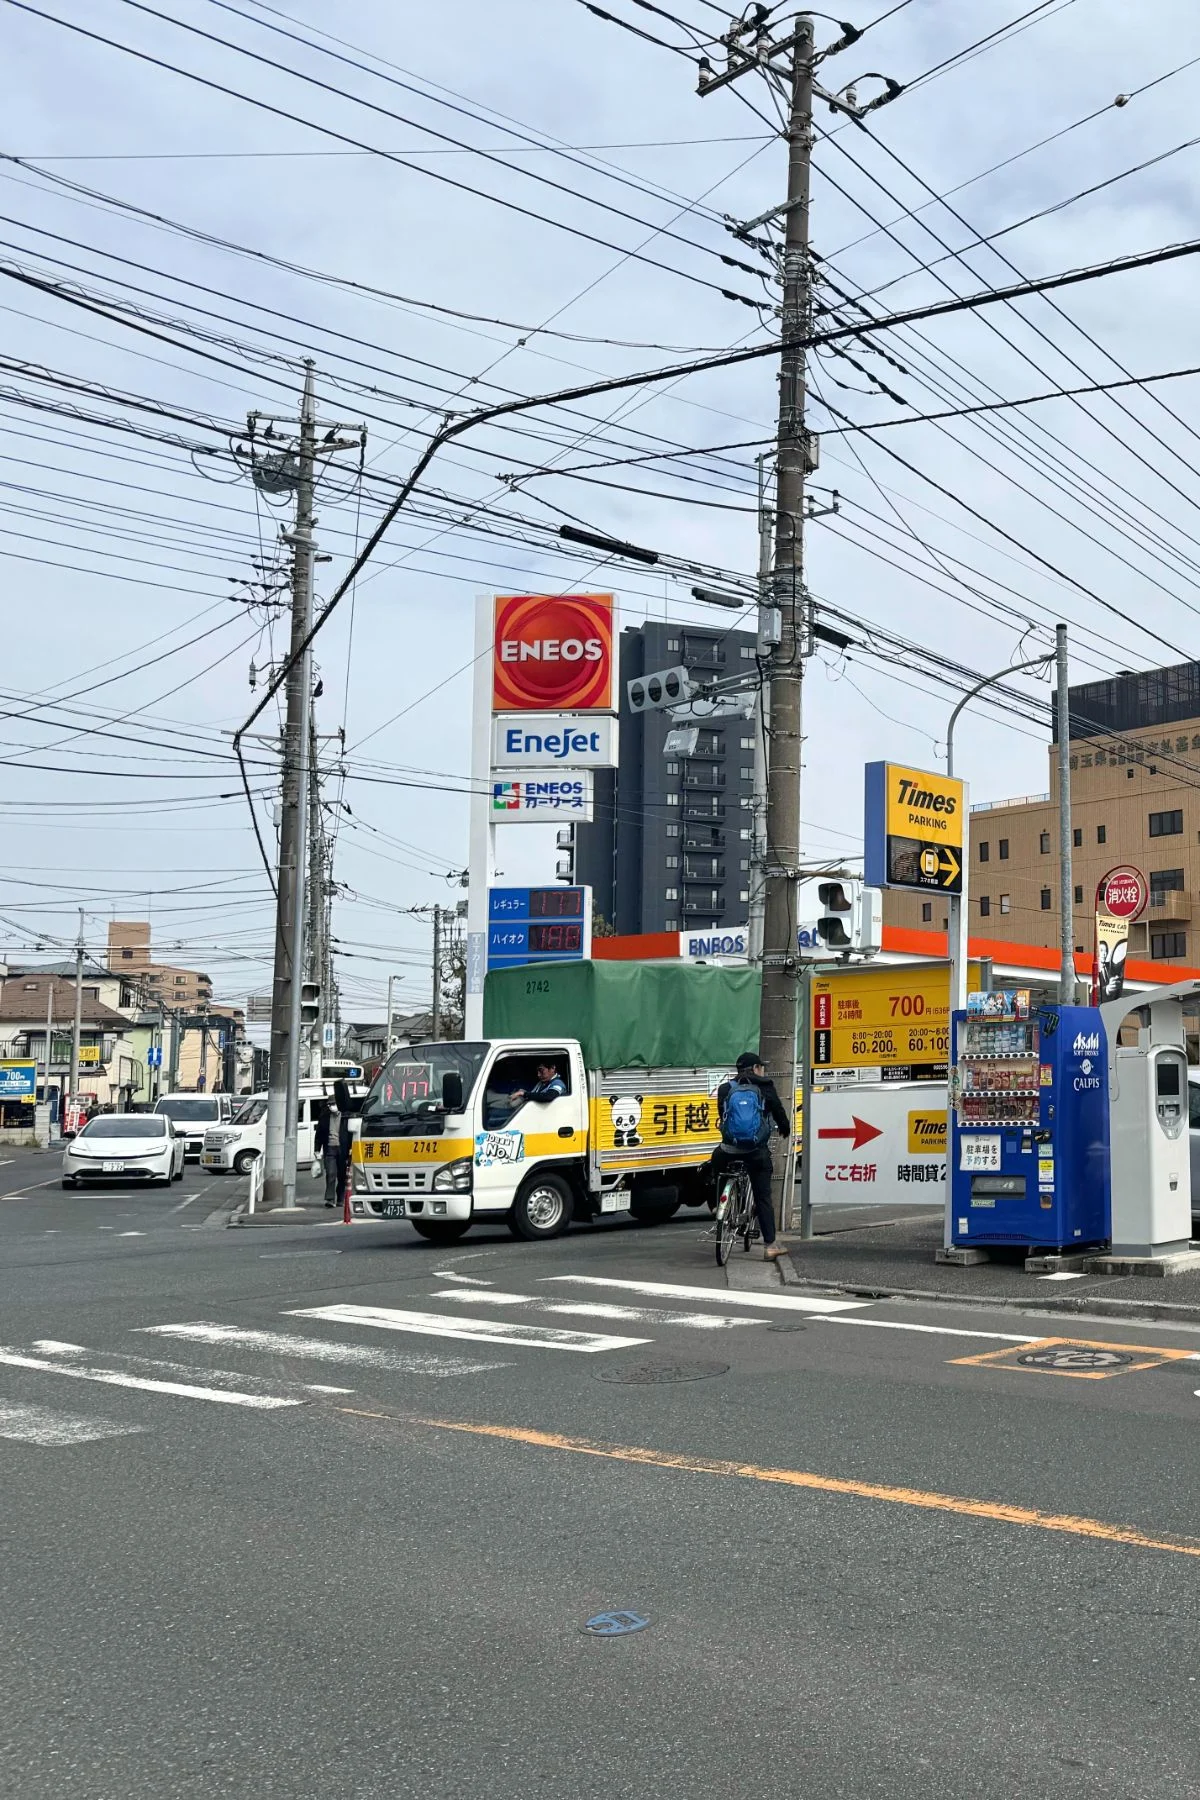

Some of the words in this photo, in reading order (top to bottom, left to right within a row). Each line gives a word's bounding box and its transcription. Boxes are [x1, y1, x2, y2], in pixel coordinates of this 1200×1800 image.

[501, 638, 603, 662] ENEOS
[525, 782, 583, 795] ENEOS
[525, 796, 583, 809] カーリース
[898, 779, 956, 815] Times
[908, 813, 947, 830] PARKING
[1108, 886, 1138, 904] 消火栓
[493, 899, 526, 910] レギュラー
[542, 891, 581, 914] 177
[493, 933, 525, 944] ハイオク
[689, 935, 745, 956] ENEOS
[526, 980, 550, 994] 2742
[838, 1000, 860, 1010] 駐車後
[838, 1010, 862, 1021] 24時間
[1073, 1032, 1100, 1050] Asahi
[1073, 1077, 1100, 1091] CALPIS
[913, 1119, 947, 1135] Time
[364, 1142, 391, 1159] 浦和
[413, 1141, 438, 1153] 2742
[966, 1144, 998, 1155] 駐車場を
[966, 1155, 998, 1166] 予約する
[824, 1164, 877, 1182] ここ右折
